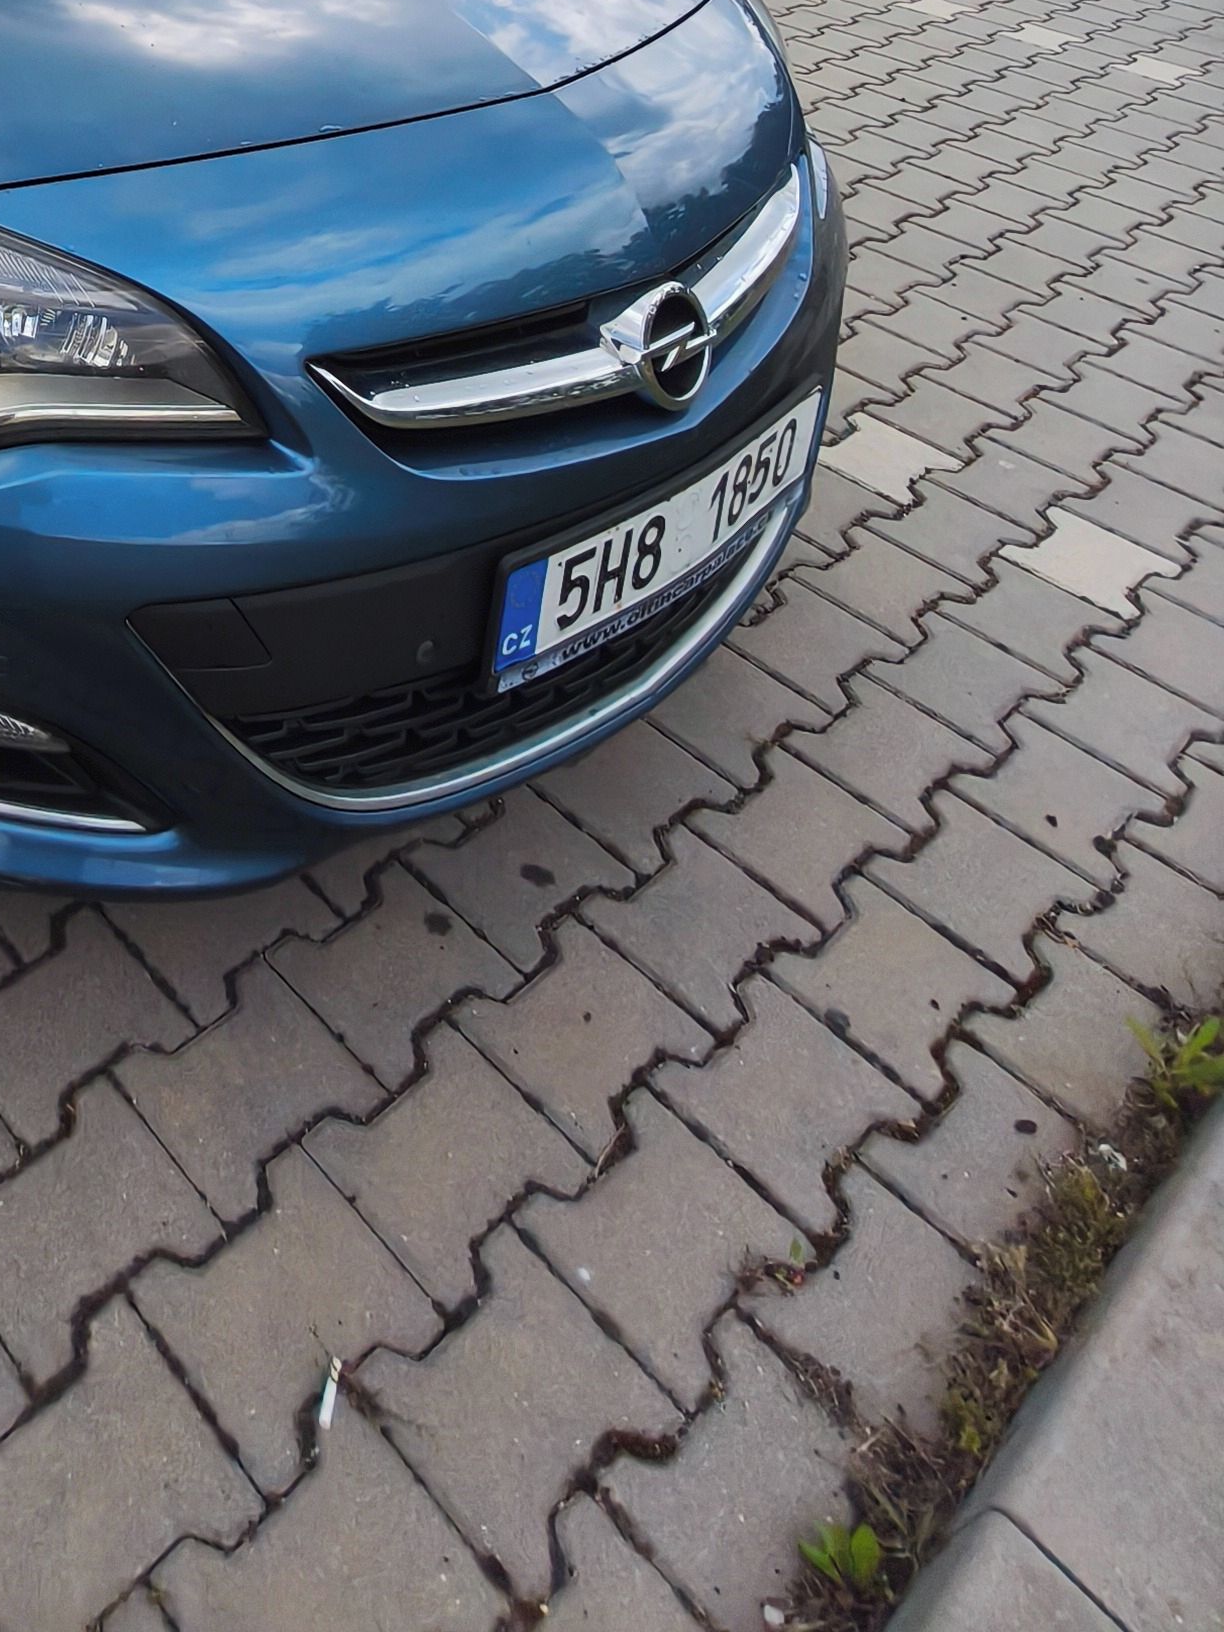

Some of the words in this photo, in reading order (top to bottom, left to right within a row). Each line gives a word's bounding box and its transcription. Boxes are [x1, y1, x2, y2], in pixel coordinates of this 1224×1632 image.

[556, 514, 666, 631] 5H8
[707, 417, 797, 543] 1850
[502, 624, 533, 655] CZ
